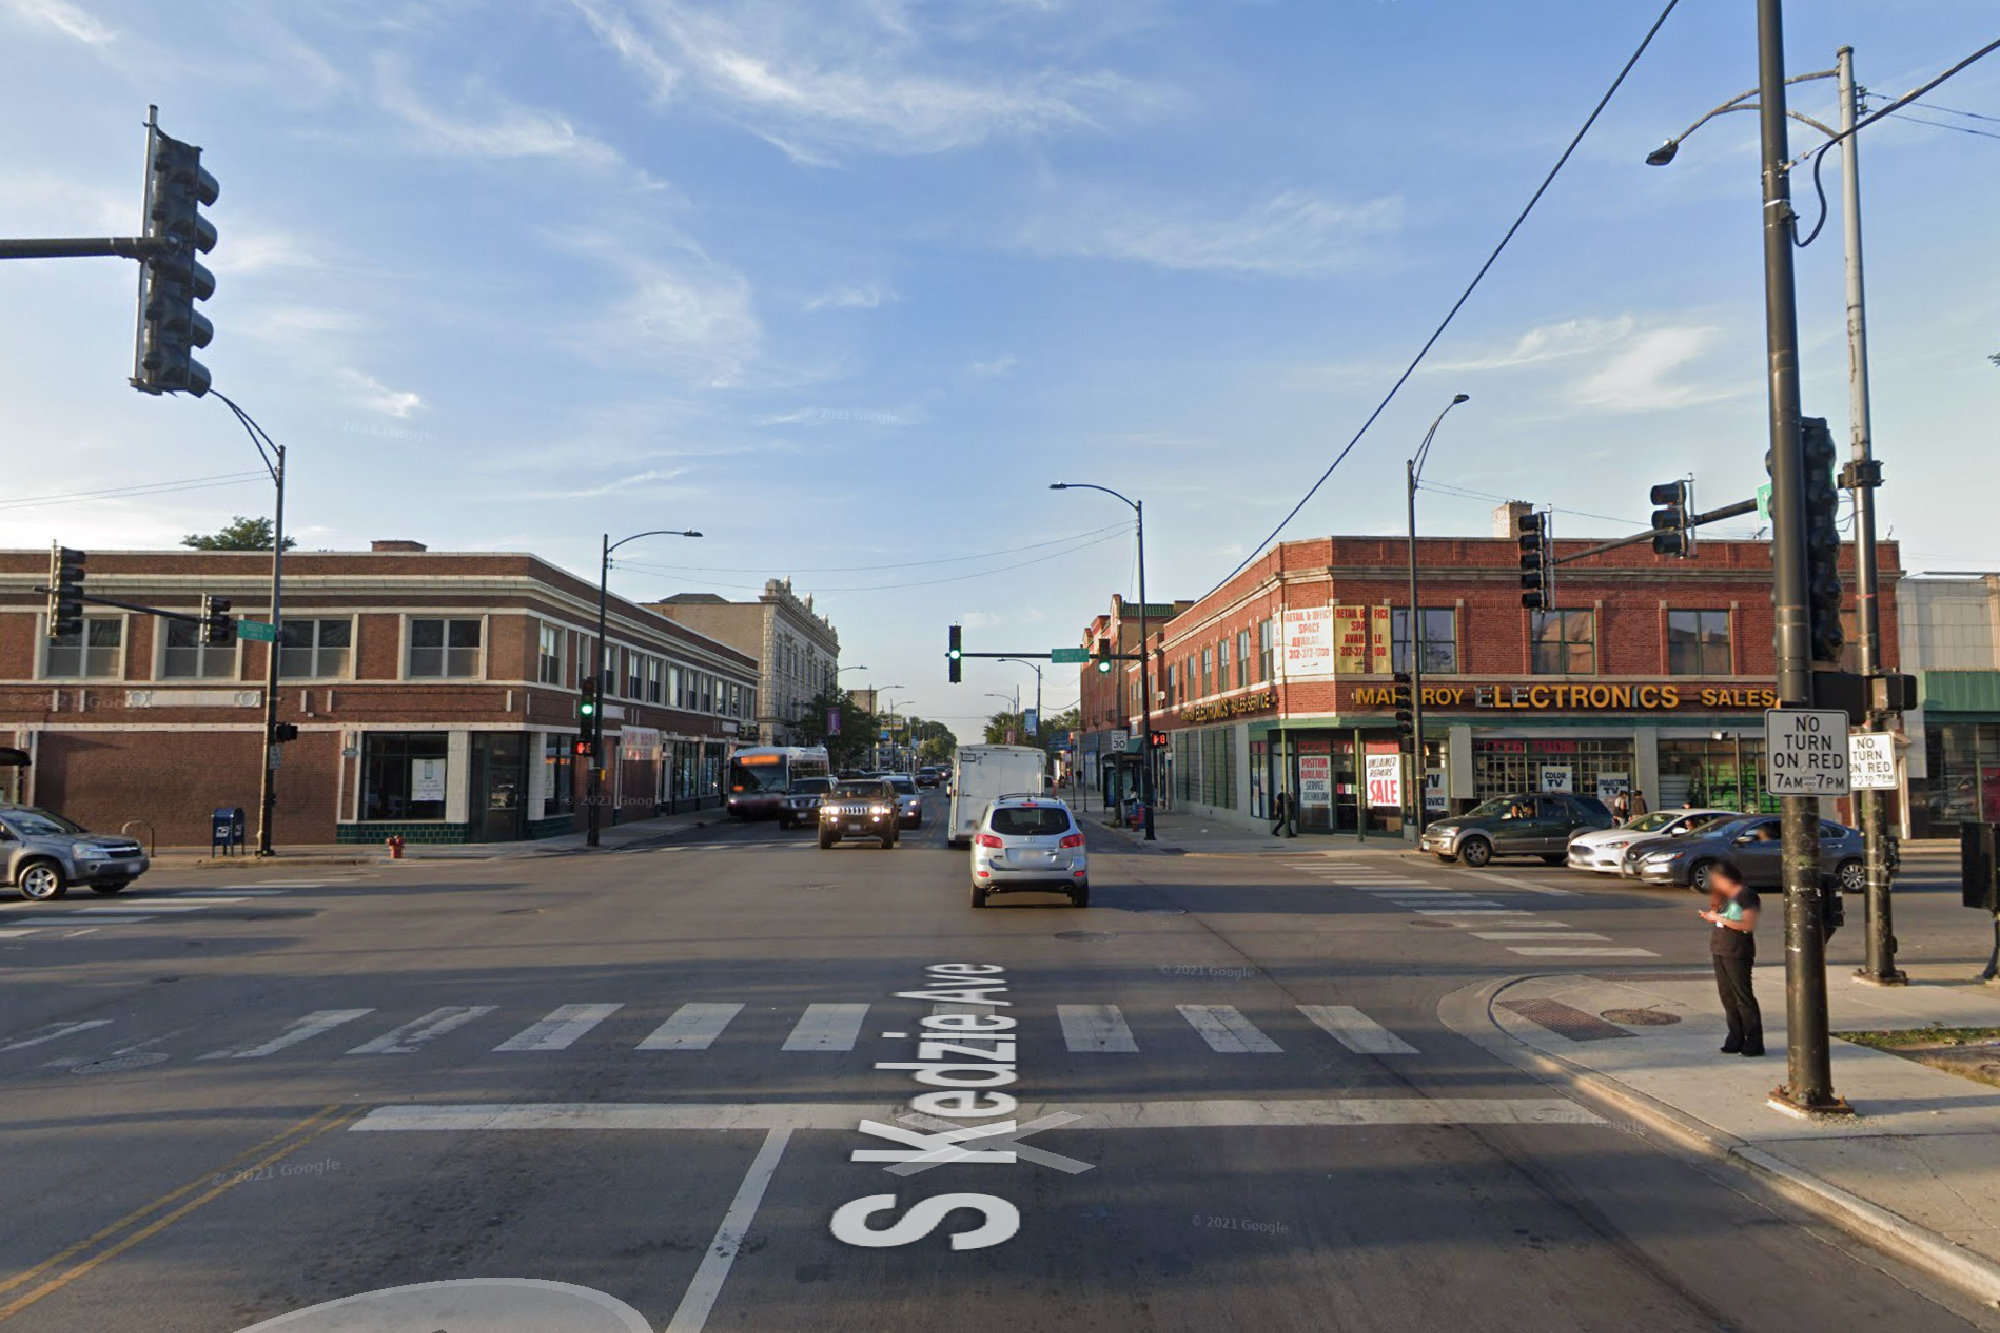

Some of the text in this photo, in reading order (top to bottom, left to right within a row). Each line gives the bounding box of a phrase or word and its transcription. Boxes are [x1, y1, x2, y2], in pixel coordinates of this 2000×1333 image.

[1286, 612, 1305, 622] RETAIL
[1336, 609, 1357, 618] RETAIL
[1298, 623, 1319, 634] SPACE
[1475, 685, 1679, 708] ELECTRONICS
[1702, 689, 1774, 707] SALES
[1796, 716, 1820, 732] NO
[1113, 740, 1125, 749] 30
[1784, 734, 1831, 751] TURN
[1857, 738, 1875, 749] NO
[1852, 750, 1883, 760] TURN
[1302, 757, 1328, 769] POSITION
[1368, 757, 1397, 768] UNCLAIMED
[1774, 752, 1843, 769] ON RED
[1868, 761, 1890, 772] RED
[1301, 770, 1329, 780] AVAILABLE
[1370, 768, 1393, 777] REPAIRS
[1545, 772, 1566, 780] COLOR
[1306, 781, 1324, 790] SERVICE
[1774, 773, 1803, 788] 7AM
[1816, 774, 1844, 789] 7PM
[1370, 779, 1397, 804] SALE
[1604, 787, 1620, 795] TV
[1303, 792, 1329, 801] TECHNICIAN
[1426, 797, 1445, 806] ERVICE
